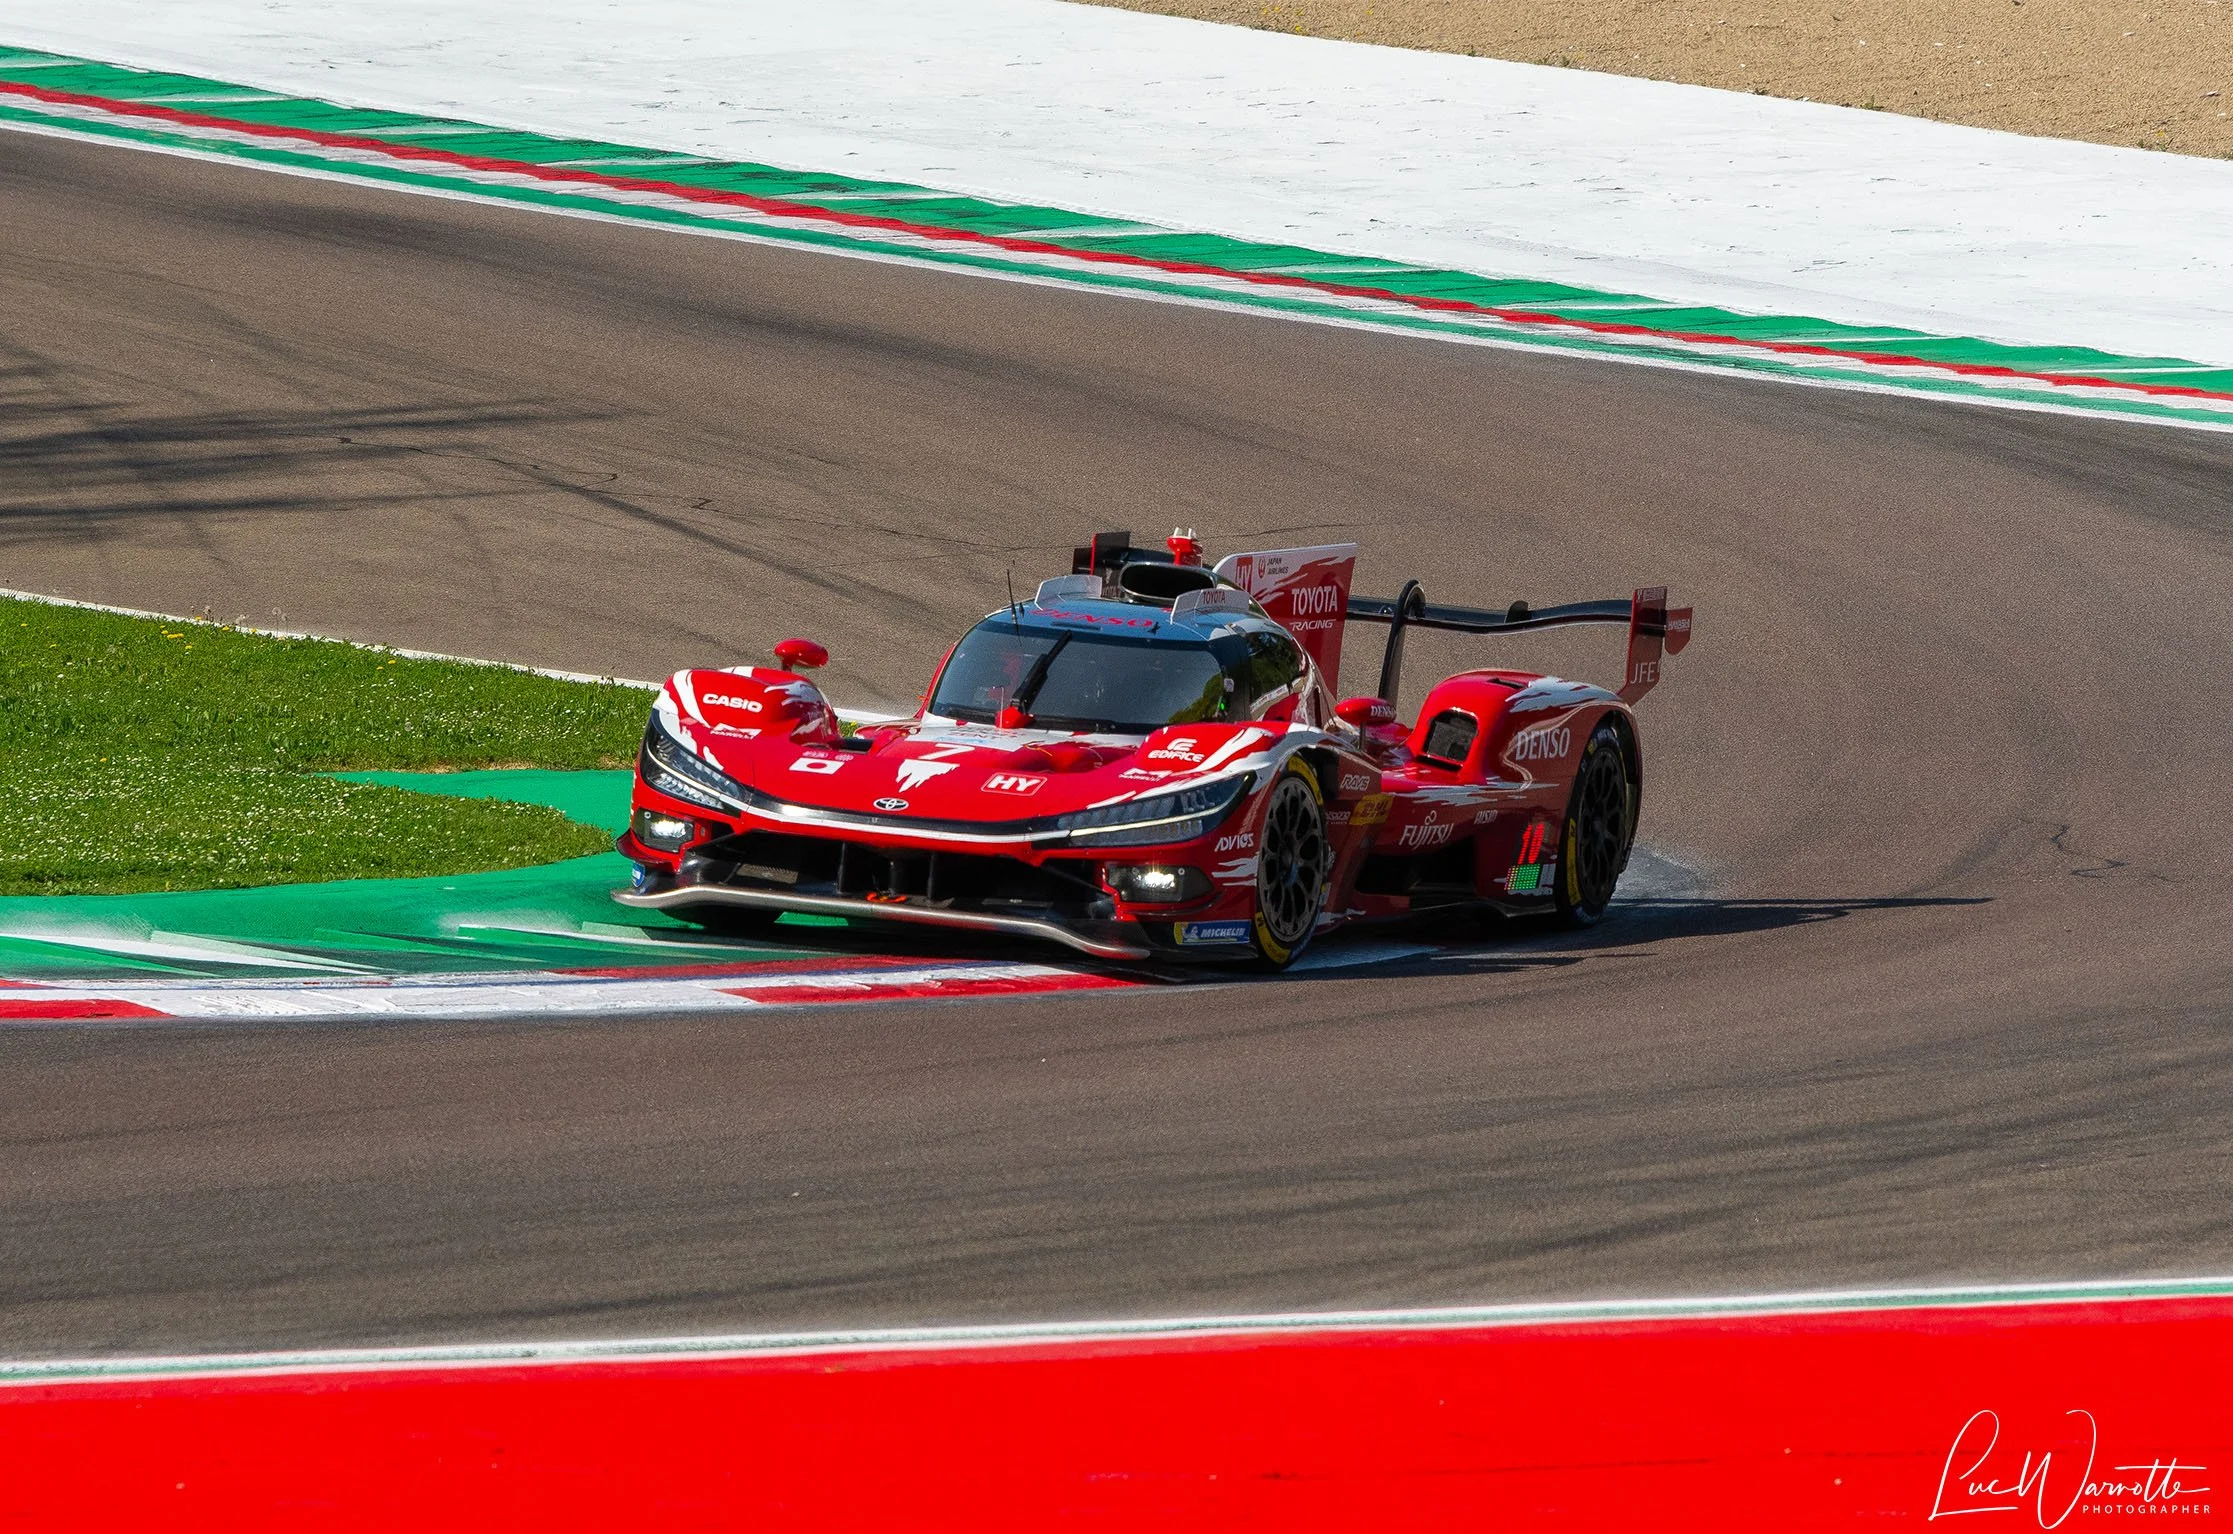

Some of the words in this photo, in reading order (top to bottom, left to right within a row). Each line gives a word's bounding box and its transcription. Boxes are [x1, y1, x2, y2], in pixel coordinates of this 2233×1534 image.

[1203, 591, 1226, 604] TOYOTA
[1291, 585, 1338, 616] TOYOTA
[1289, 618, 1336, 632] RACING
[1630, 661, 1657, 684] JFE
[702, 693, 763, 713] CASIO
[1515, 727, 1571, 761] DENSO
[1148, 749, 1205, 763] EDIFICE
[987, 775, 1040, 793] HY
[1340, 774, 1370, 791] RAYS
[1200, 927, 1246, 938] MICHELIN
